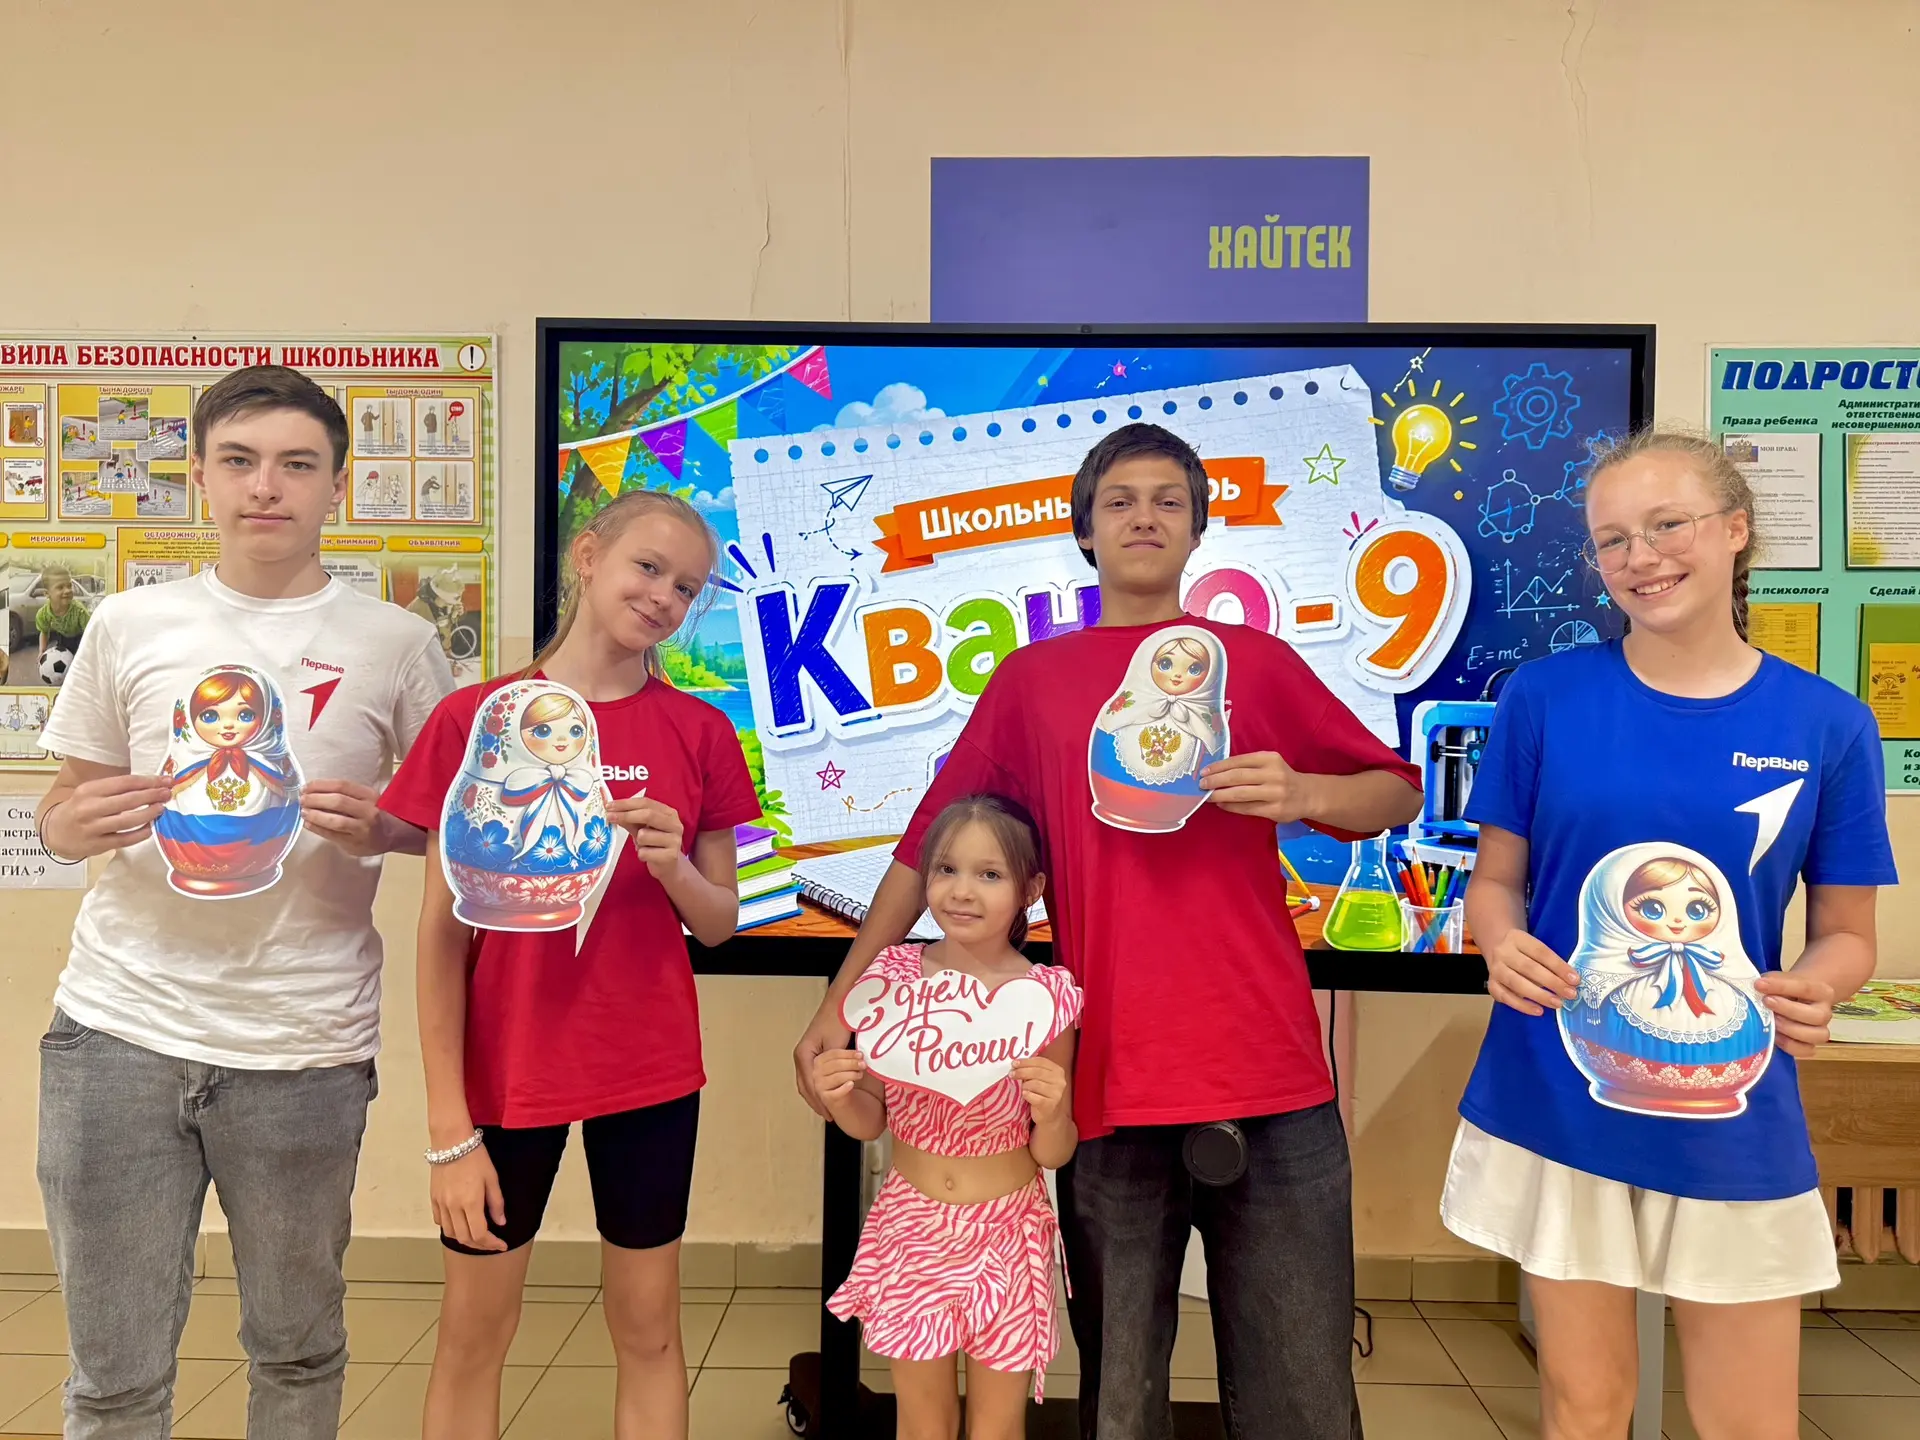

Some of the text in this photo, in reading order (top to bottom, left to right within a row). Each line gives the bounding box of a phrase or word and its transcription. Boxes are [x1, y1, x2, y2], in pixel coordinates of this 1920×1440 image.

[1209, 214, 1351, 268] ХАЙТЕК
[1, 344, 439, 368] ВИЛА БЕЗОПАСНОСТИ ШКОЛЬНИКА
[1721, 361, 1920, 390] ПОДРОСТ
[1722, 416, 1818, 428] Права ребенка
[1762, 587, 1829, 595] психолога
[1869, 586, 1917, 597] Сделай
[301, 657, 345, 674] Первые
[1732, 751, 1810, 772] Первые
[2, 865, 30, 876] ГИА
[837, 970, 988, 1060] С днём
[907, 1021, 1034, 1076] России!
